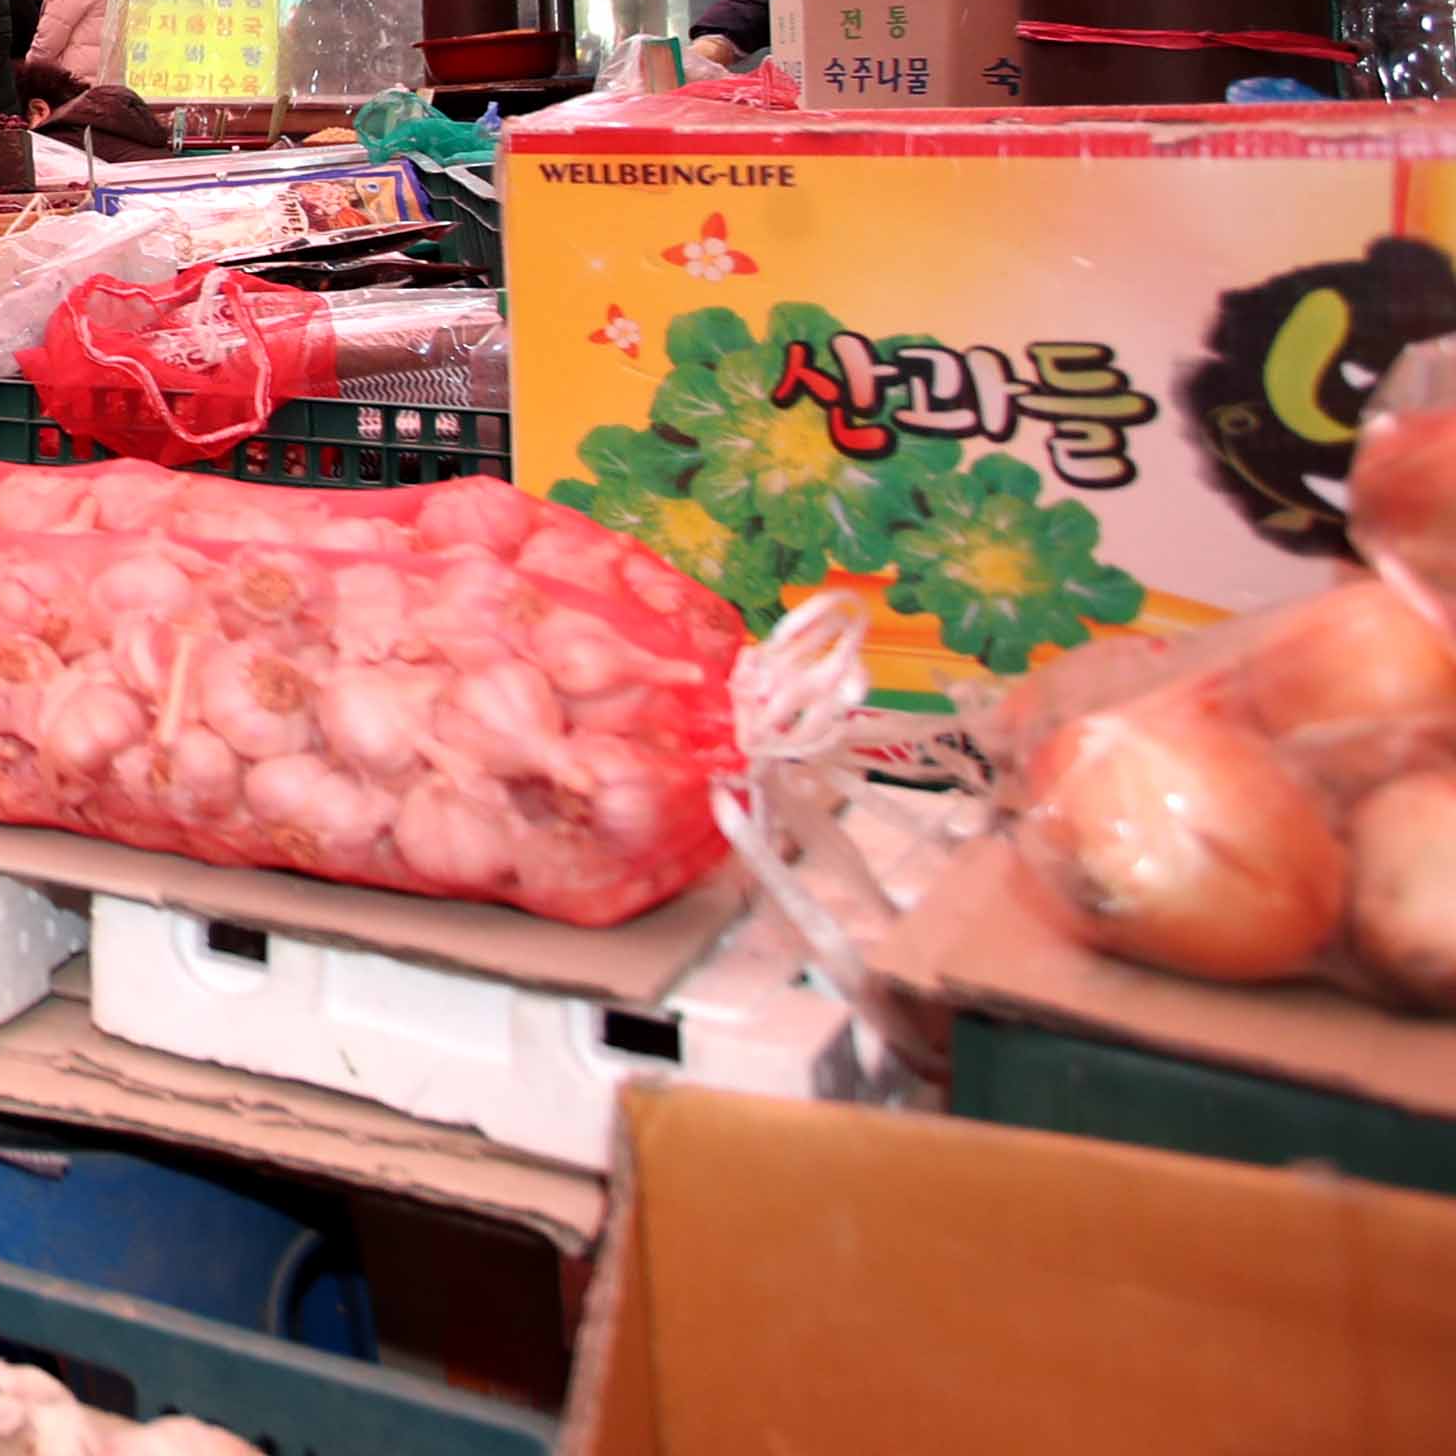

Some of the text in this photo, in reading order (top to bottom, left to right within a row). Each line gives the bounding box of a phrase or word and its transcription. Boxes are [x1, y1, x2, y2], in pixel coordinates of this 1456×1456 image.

[840, 4, 909, 41] 전통
[823, 57, 930, 95] 숙주나물
[538, 160, 798, 191] WELLBEING-LIFE
[770, 328, 1158, 490] 산과들
